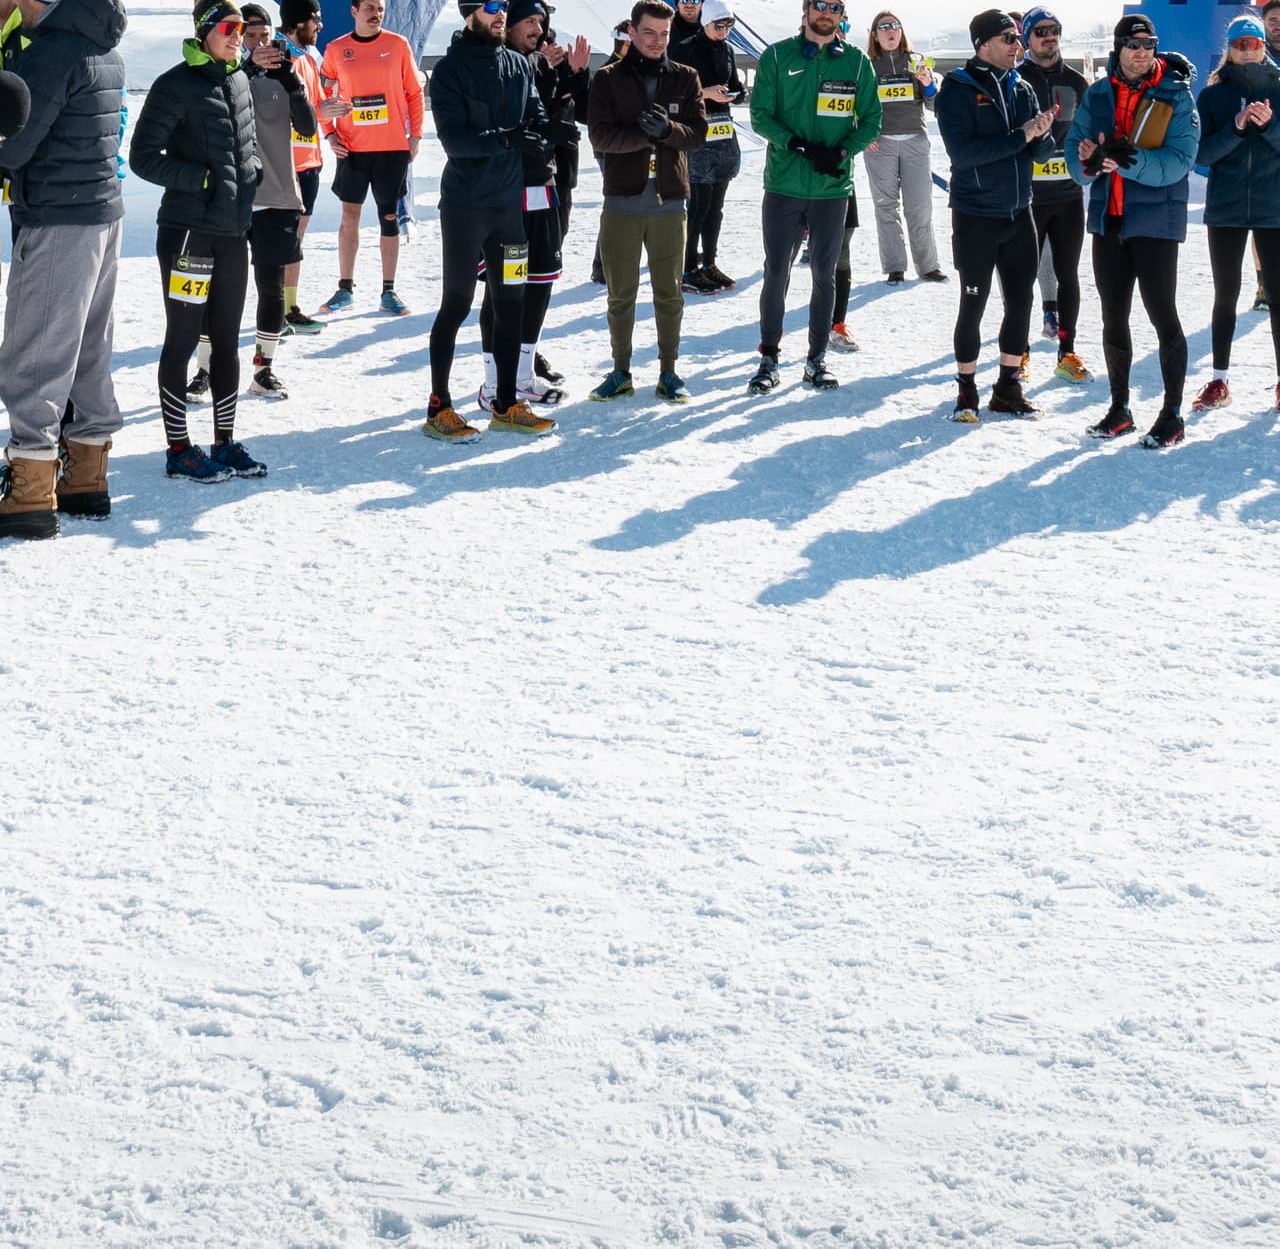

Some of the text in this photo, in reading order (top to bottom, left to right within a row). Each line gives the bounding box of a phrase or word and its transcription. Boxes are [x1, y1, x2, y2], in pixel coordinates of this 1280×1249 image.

[885, 87, 907, 98] 452
[827, 98, 852, 112] 450
[359, 109, 381, 121] 467
[712, 125, 730, 136] 453
[1041, 162, 1066, 175] 451
